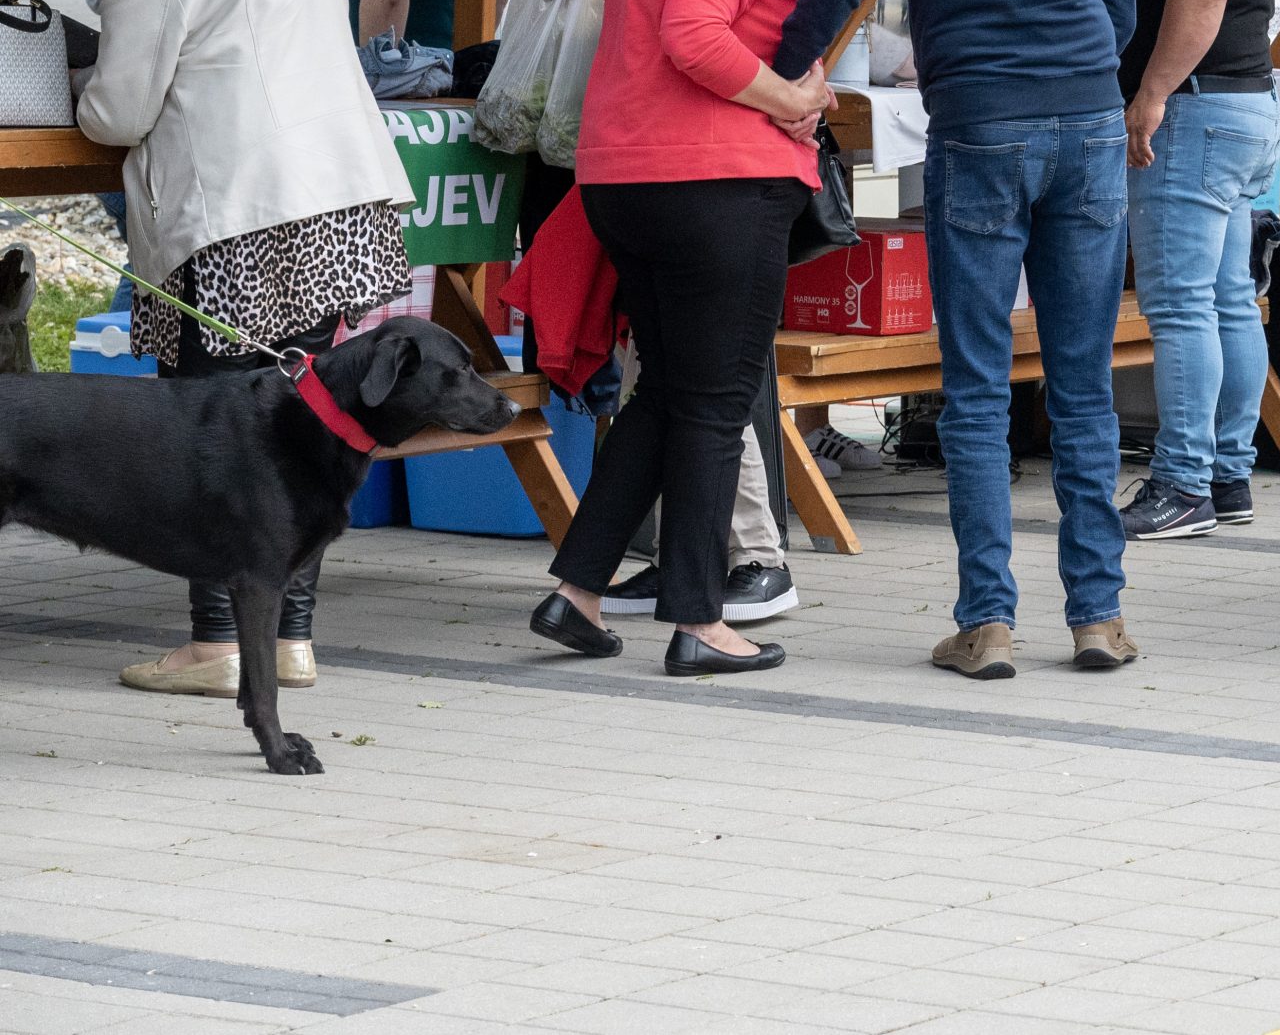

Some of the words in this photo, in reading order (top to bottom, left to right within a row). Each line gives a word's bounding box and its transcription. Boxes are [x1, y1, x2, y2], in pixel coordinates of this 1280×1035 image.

[793, 295, 830, 305] HARMONY
[831, 298, 840, 306] 35
[1152, 506, 1178, 523] bugatti
